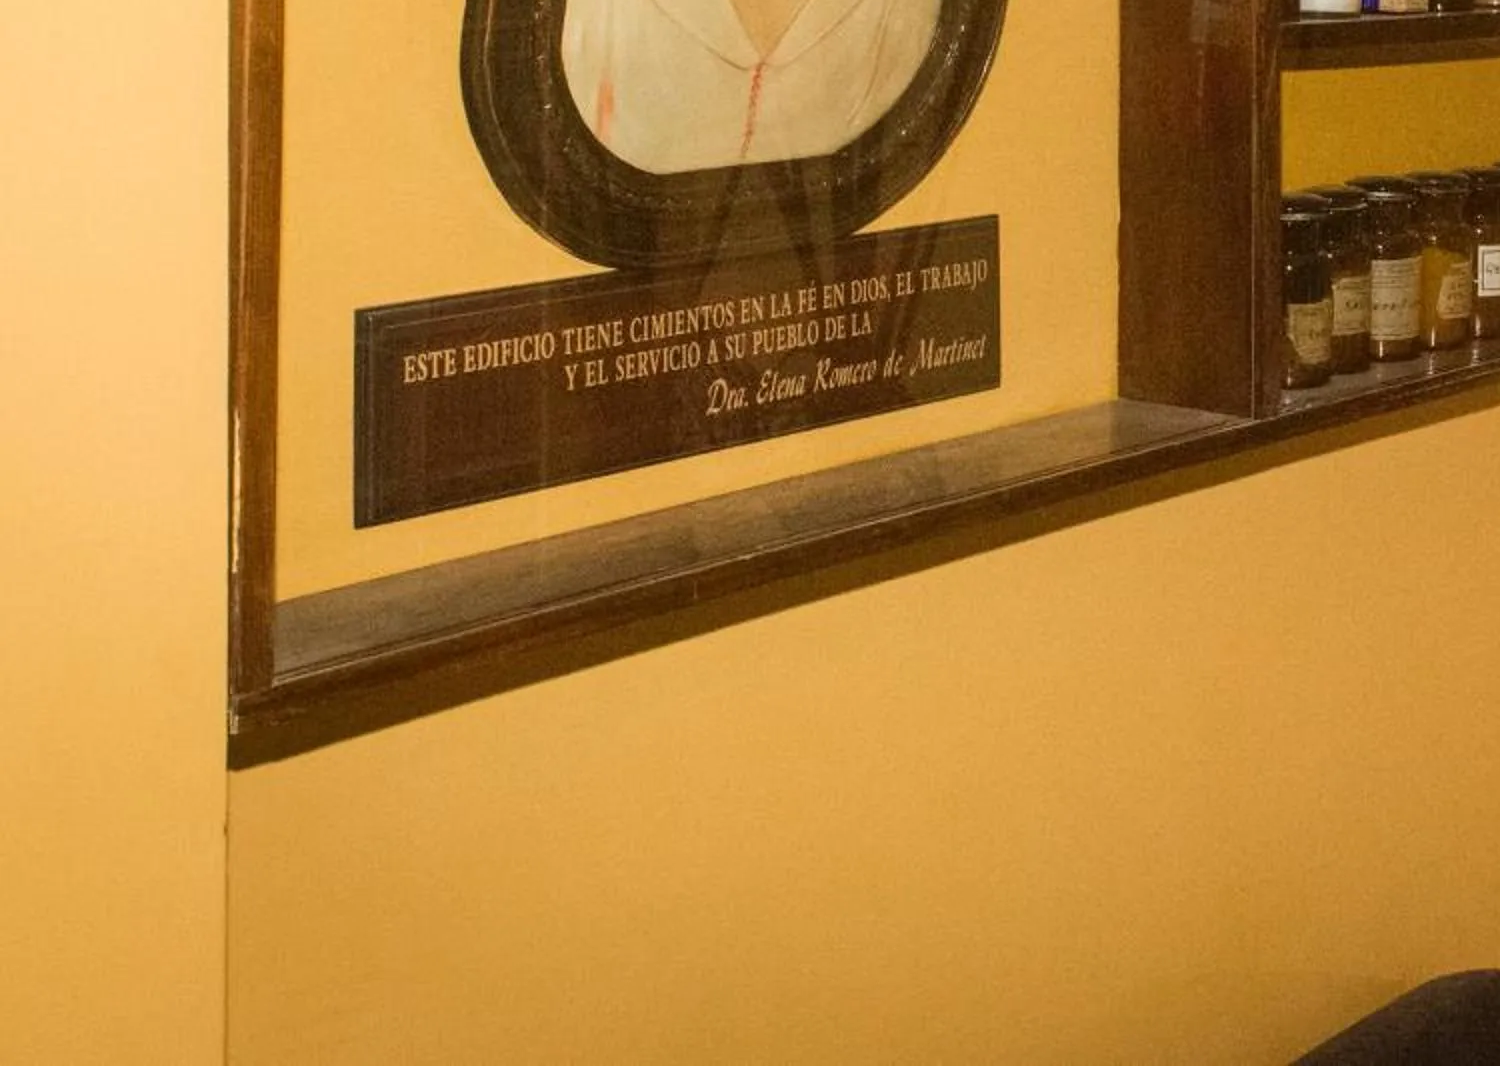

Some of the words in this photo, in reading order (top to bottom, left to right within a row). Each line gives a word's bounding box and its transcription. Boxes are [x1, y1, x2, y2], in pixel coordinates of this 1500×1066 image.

[403, 348, 457, 383] ESTE
[463, 331, 555, 373] EDIFICIO
[561, 319, 625, 355] TIENE
[629, 301, 736, 343] CIMIENTOS
[740, 295, 765, 325] EN
[769, 291, 792, 319] LA
[797, 280, 818, 315] FÉ
[823, 283, 847, 310] EN
[851, 275, 892, 304] DIOS,
[896, 269, 916, 298] EL
[920, 257, 989, 292] TRABAJO
[564, 363, 580, 392] Y
[584, 358, 609, 388] EL
[614, 340, 702, 383] SERVICIO
[705, 338, 720, 366] A
[724, 332, 748, 362] SU
[752, 319, 820, 356] PUEBLO
[824, 314, 848, 343] DE
[851, 310, 873, 338] LA
[704, 377, 750, 417] Dra.
[755, 367, 807, 405] Elena
[813, 355, 878, 394] Romero
[883, 347, 905, 379] de
